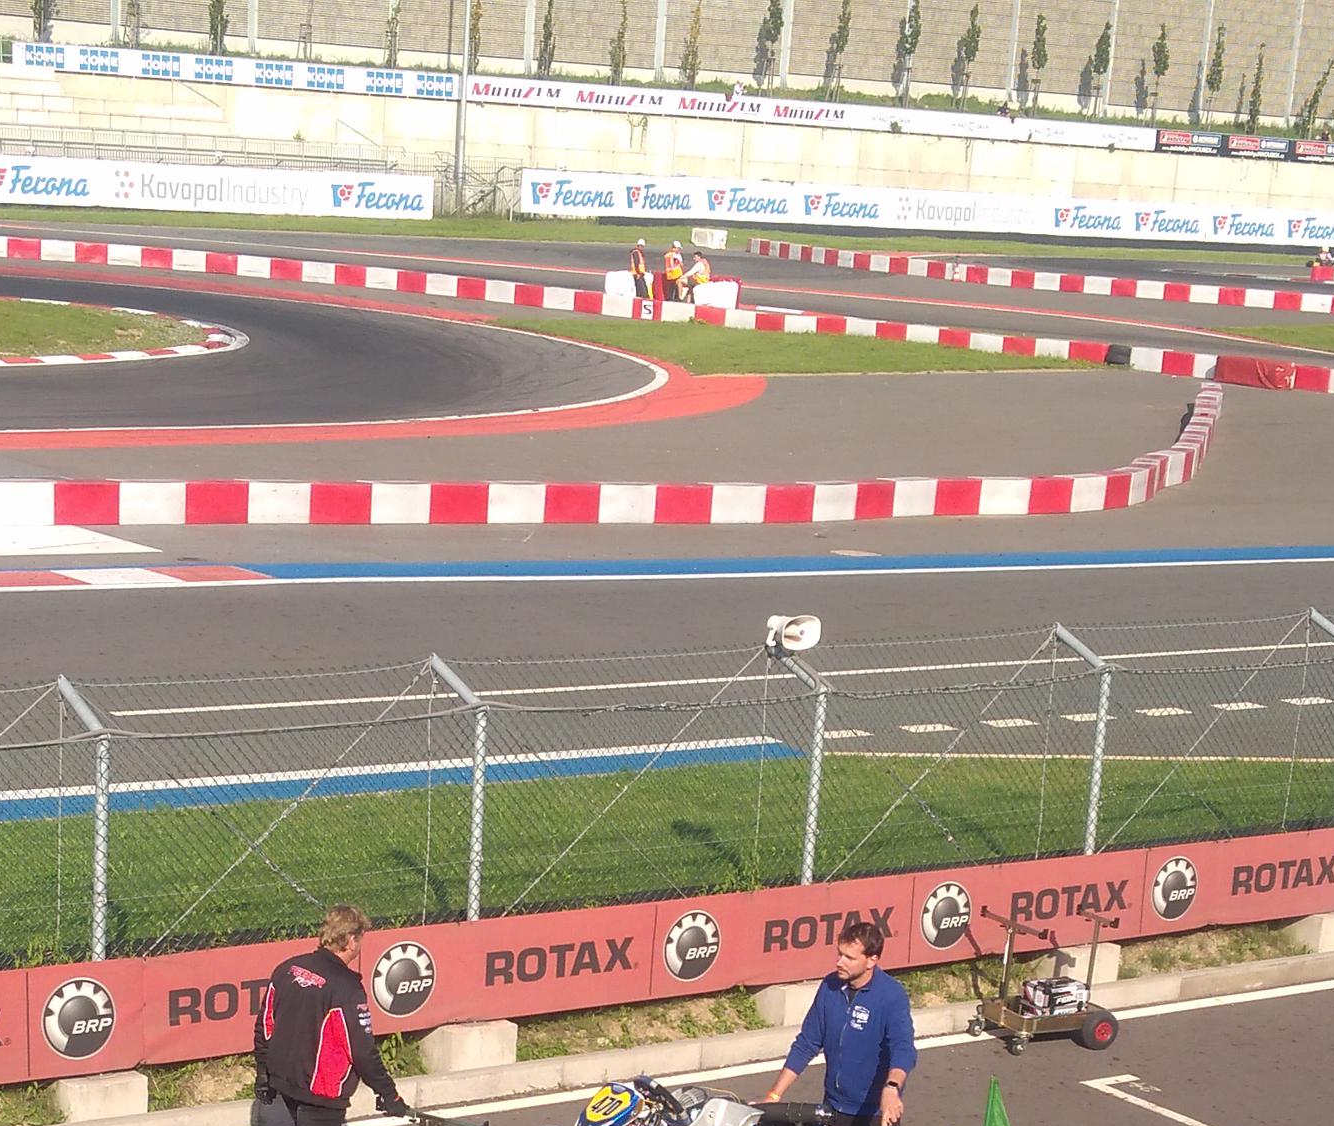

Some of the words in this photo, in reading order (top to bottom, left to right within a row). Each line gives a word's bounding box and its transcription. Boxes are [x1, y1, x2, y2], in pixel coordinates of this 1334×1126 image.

[9, 165, 90, 197] Ferona
[552, 180, 614, 208] Ferona
[354, 182, 424, 212] Ferona
[641, 184, 692, 211] Ferona
[726, 187, 788, 215] Ferona
[822, 192, 879, 219] Ferona
[1070, 206, 1122, 232] Ferona
[1150, 209, 1199, 235] Ferona
[1226, 212, 1275, 238] Ferona
[1010, 880, 1129, 923] ROTAX
[1169, 887, 1195, 902] BRP
[939, 914, 968, 930] BRP
[484, 936, 633, 987] ROTAX
[685, 944, 718, 962] BRP
[396, 978, 432, 995] BRP
[169, 982, 266, 1026] ROT
[71, 1016, 113, 1036] BRP
[590, 1096, 623, 1116] 470
